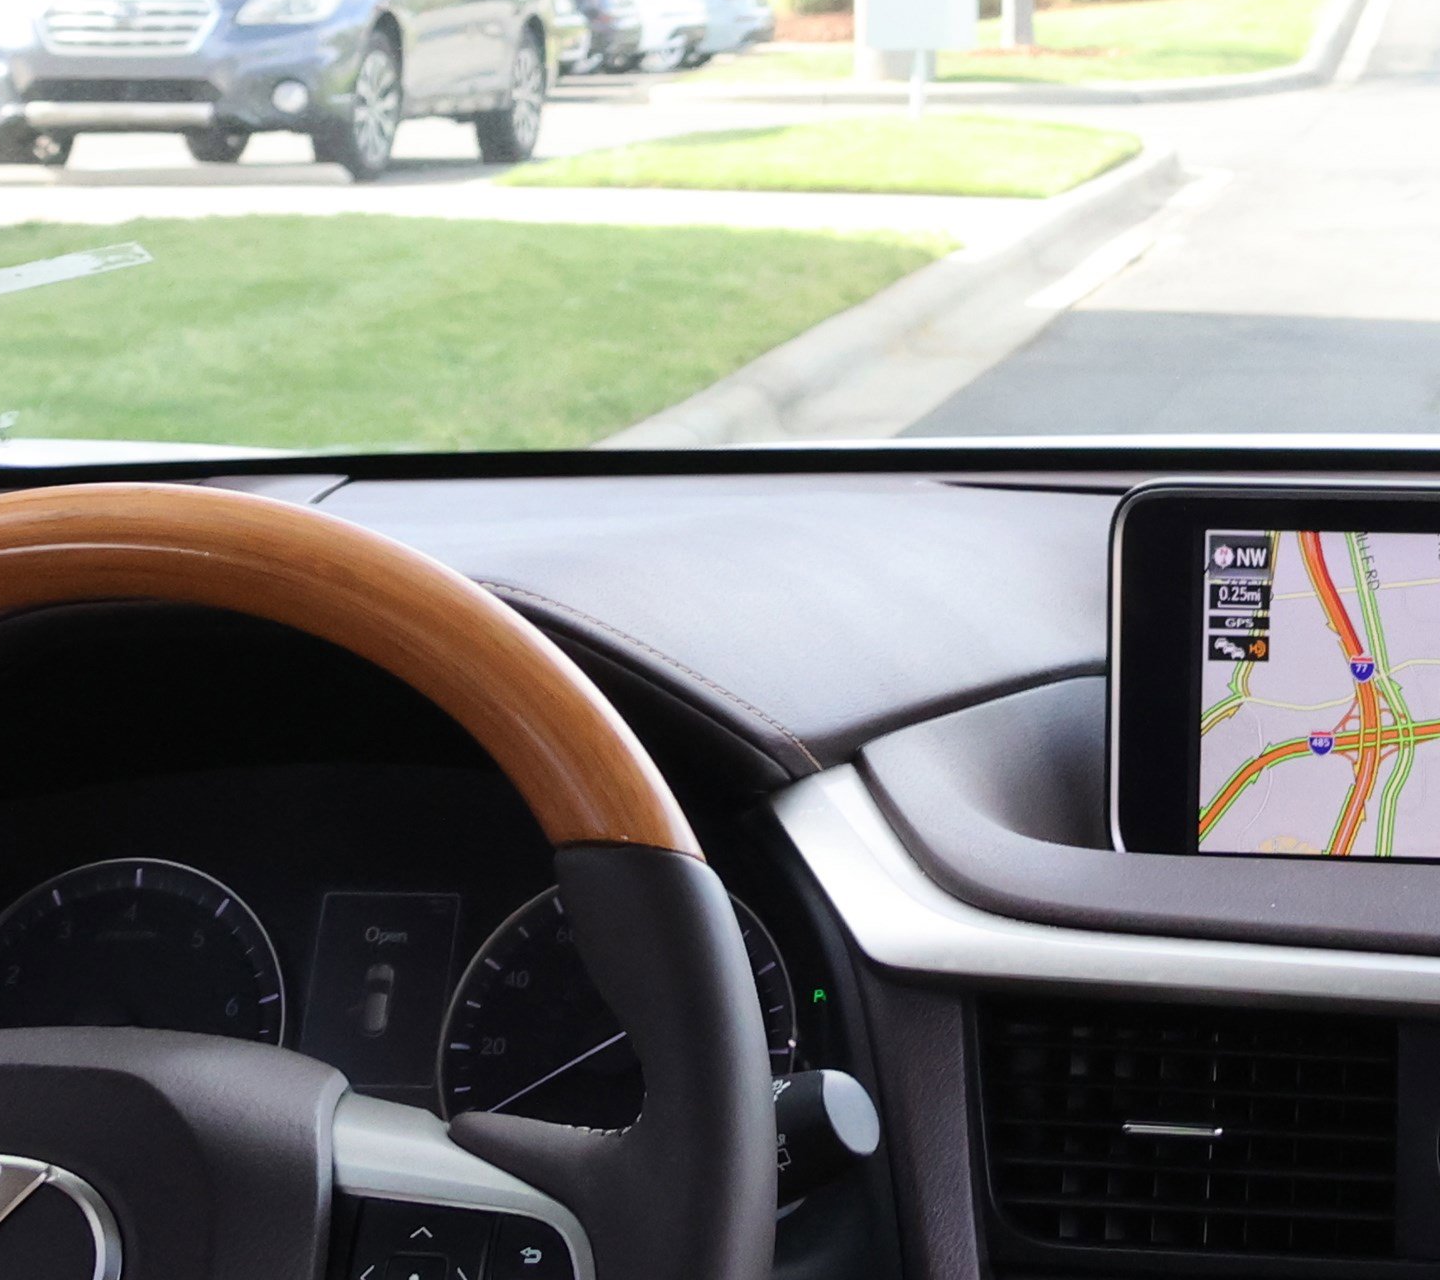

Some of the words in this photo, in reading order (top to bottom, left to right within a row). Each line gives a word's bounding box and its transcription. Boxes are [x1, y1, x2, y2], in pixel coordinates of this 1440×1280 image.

[1237, 548, 1267, 567] NW
[1219, 586, 1261, 602] 0.25mi
[1225, 618, 1254, 628] GPS
[1356, 664, 1369, 673] 77
[125, 902, 137, 922] 4
[59, 921, 72, 939] 3
[365, 926, 408, 945] Open
[191, 931, 205, 948] 5
[5, 965, 20, 984] 2
[504, 970, 530, 988] 40
[225, 998, 239, 1016] 6
[480, 1037, 506, 1055] 20
